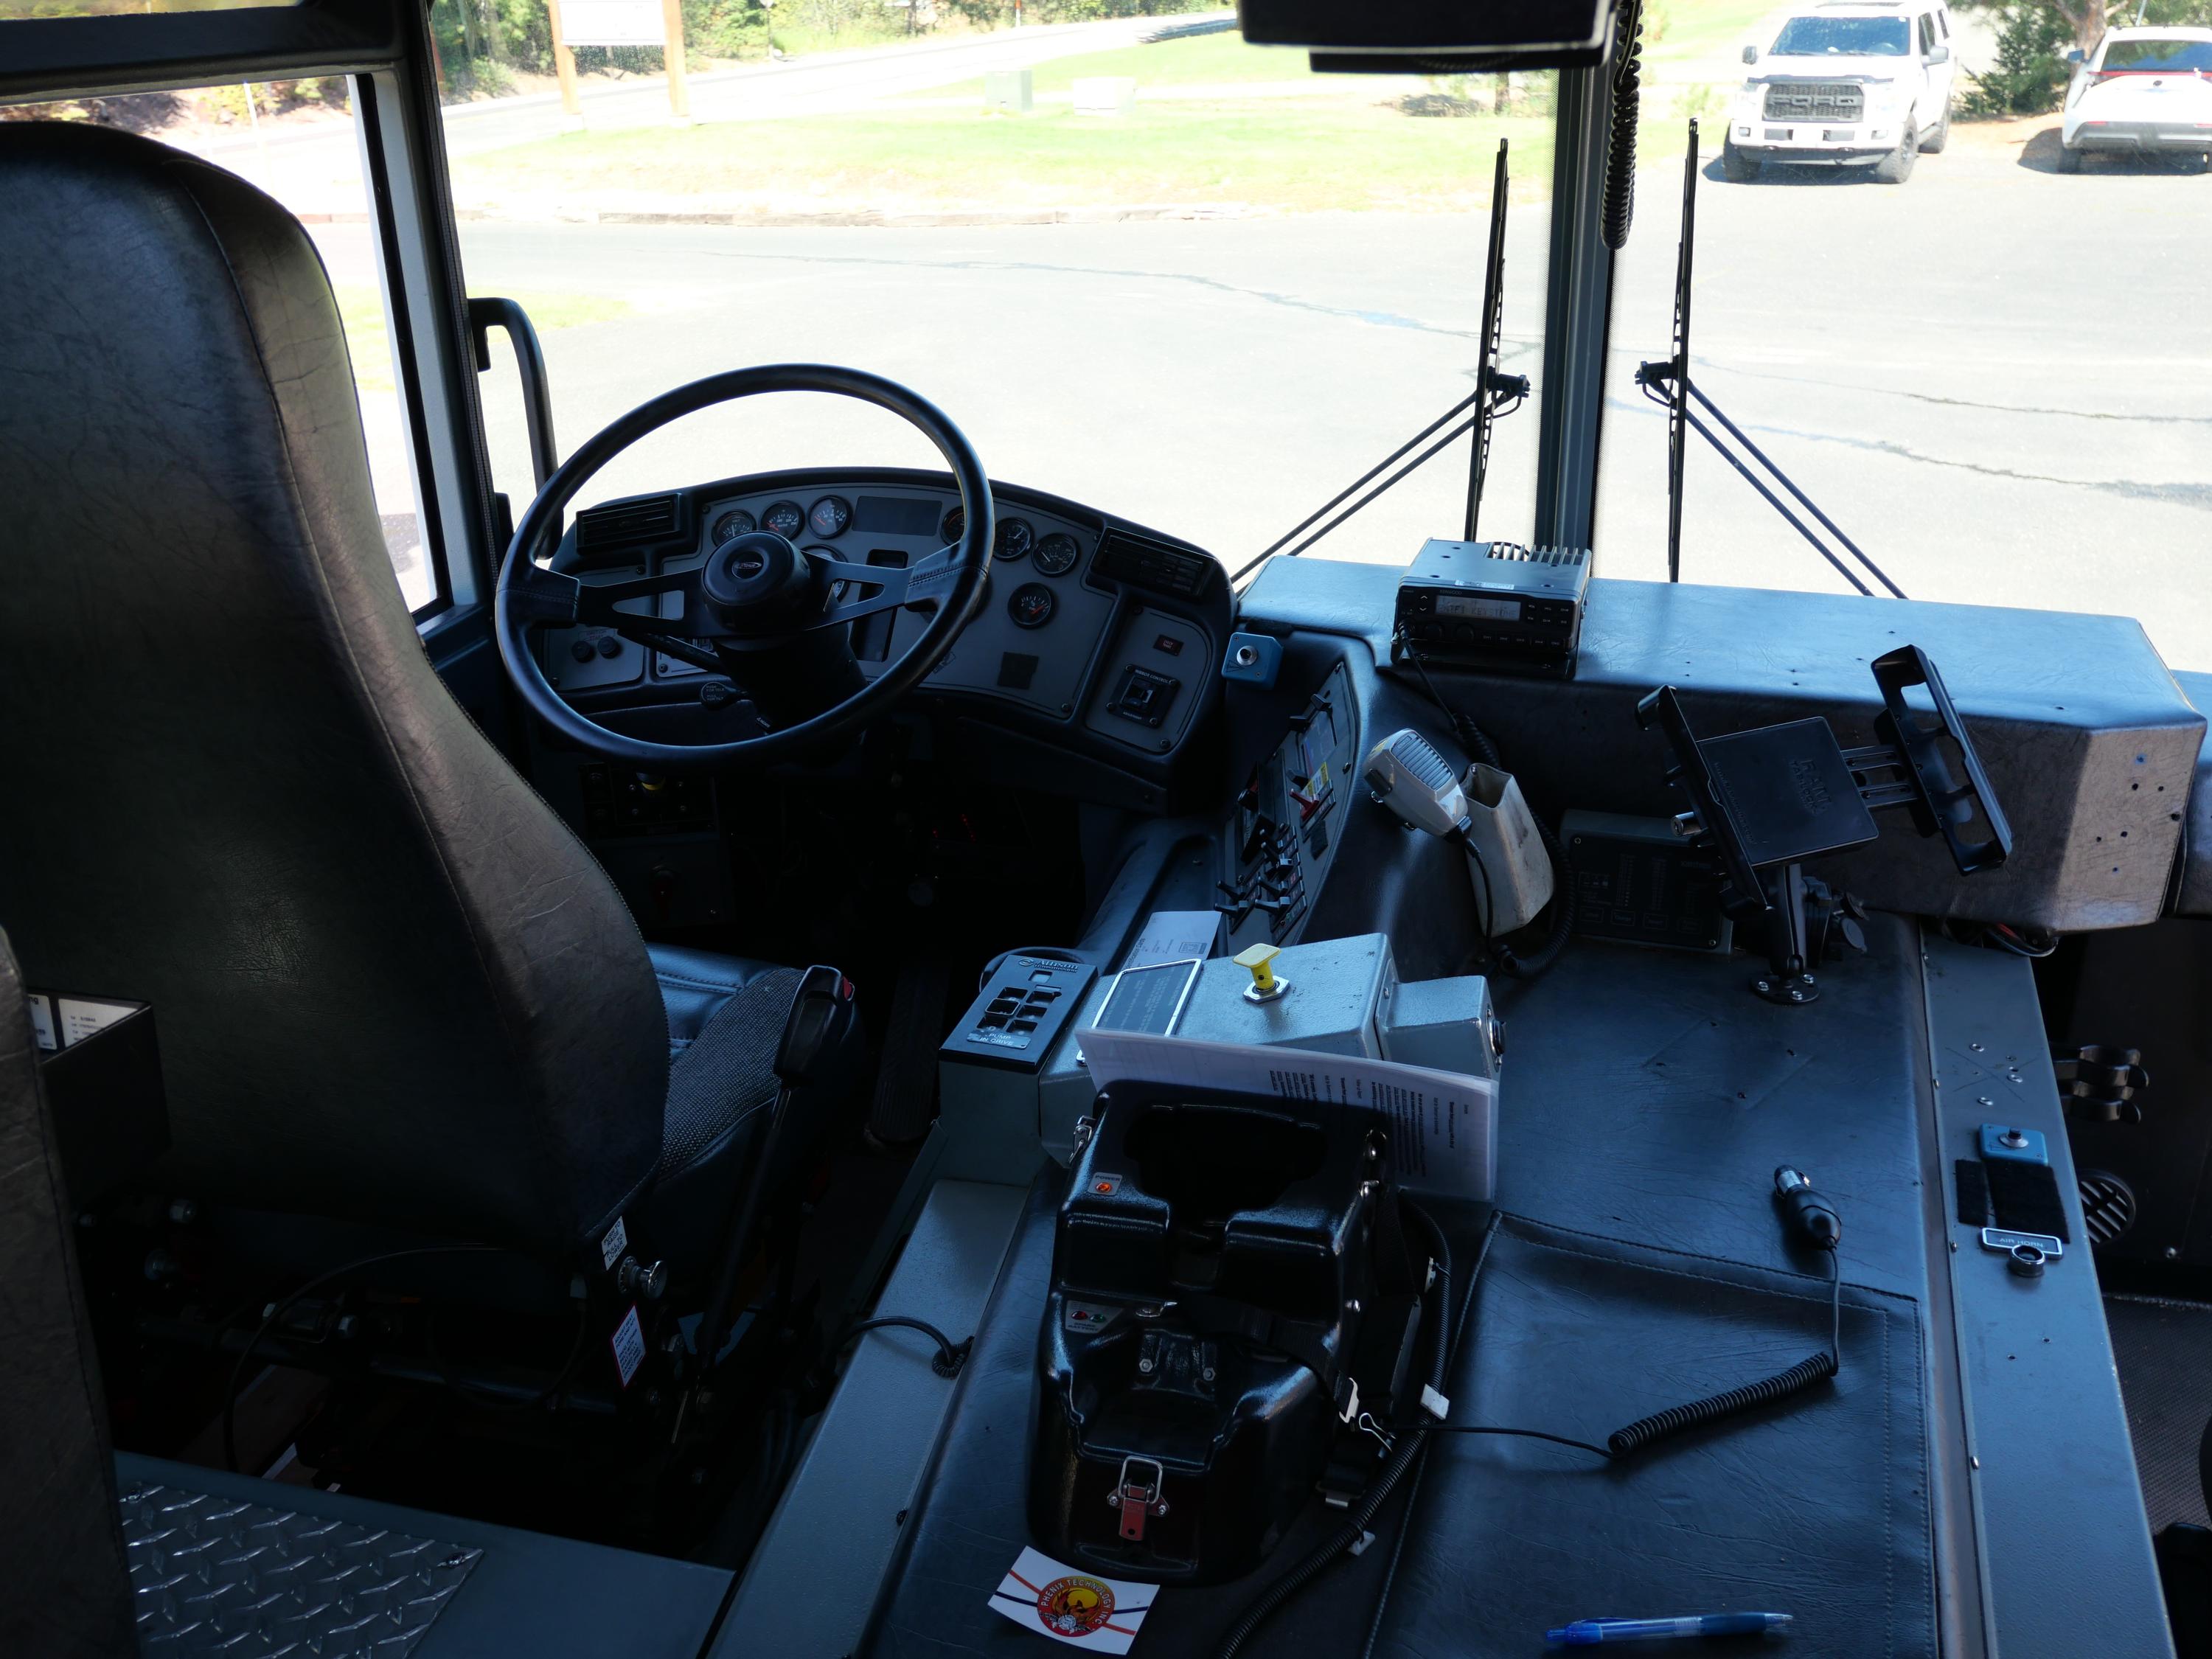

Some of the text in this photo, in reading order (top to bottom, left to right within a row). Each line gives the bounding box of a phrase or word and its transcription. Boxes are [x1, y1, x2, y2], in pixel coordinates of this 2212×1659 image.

[1768, 94, 1863, 106] FORD
[1037, 960, 1078, 970] Allison
[2017, 1239, 2044, 1248] HORN
[1040, 1582, 1065, 1607] PHENIX
[1066, 1579, 1112, 1609] TECHNOLOGY
